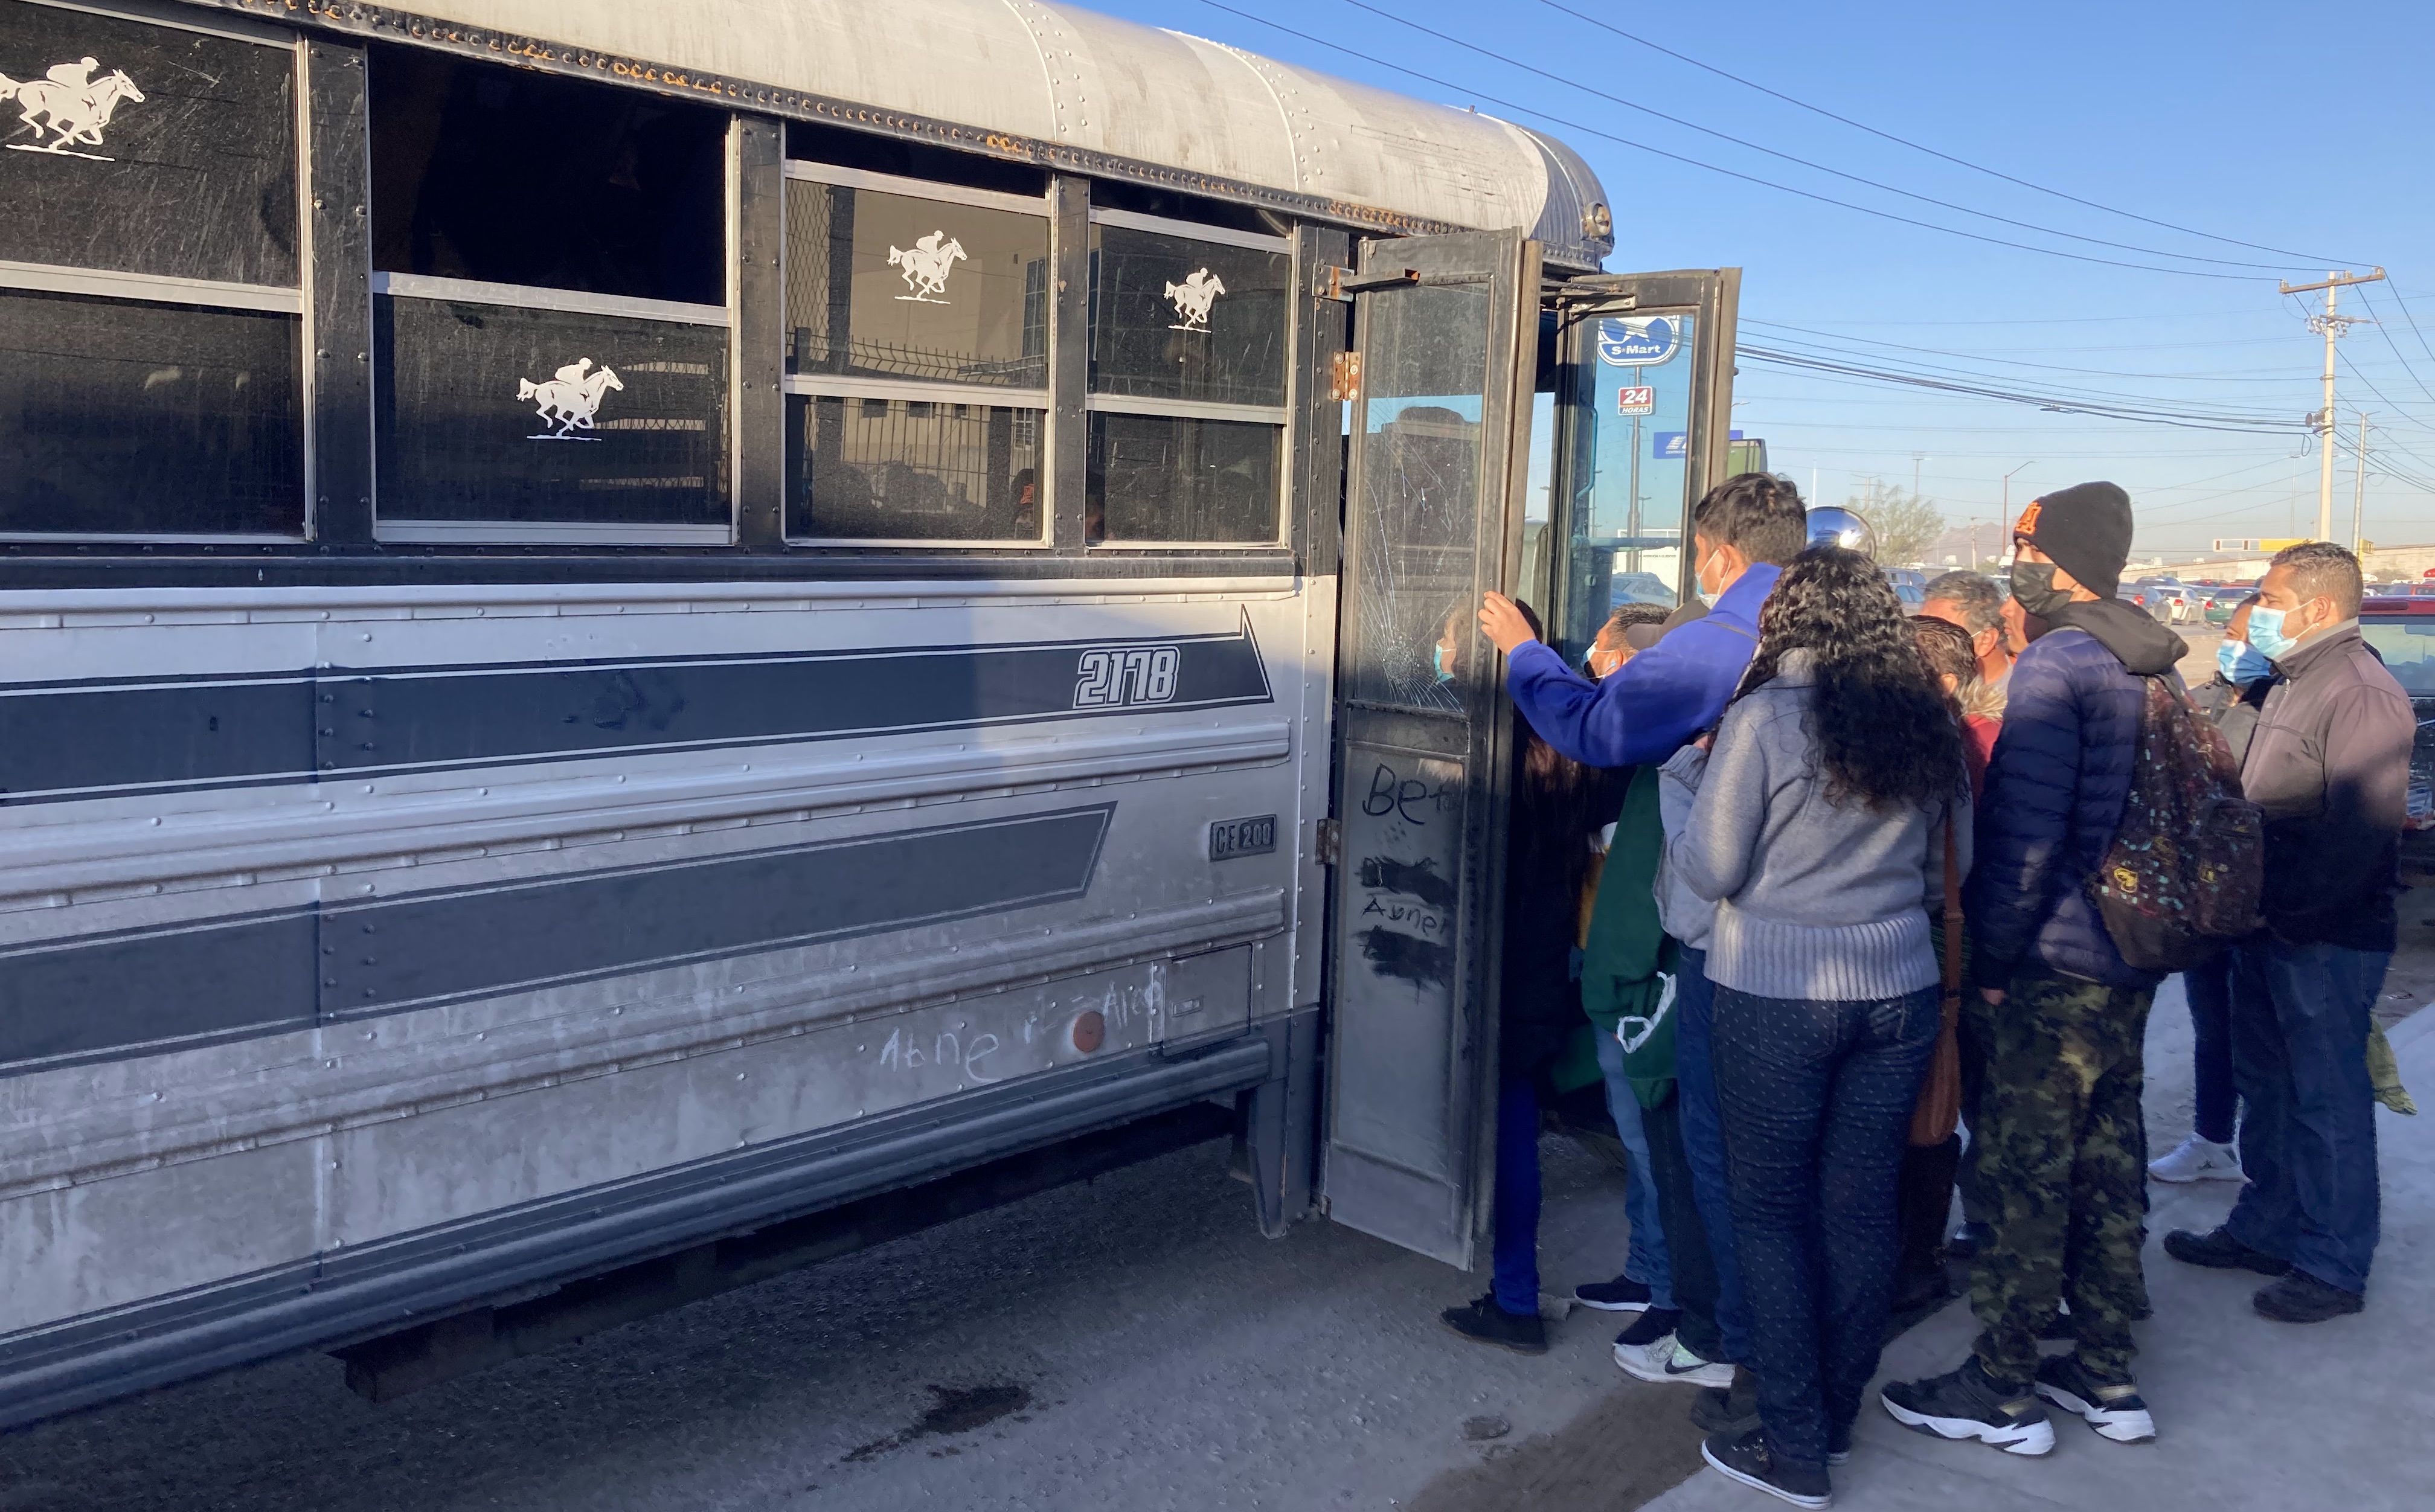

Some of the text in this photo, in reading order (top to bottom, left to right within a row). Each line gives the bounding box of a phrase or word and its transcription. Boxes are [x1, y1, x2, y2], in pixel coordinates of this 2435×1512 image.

[1623, 389, 1647, 404] 24
[1073, 647, 1180, 709] 2178
[1216, 822, 1272, 854] CE 200
